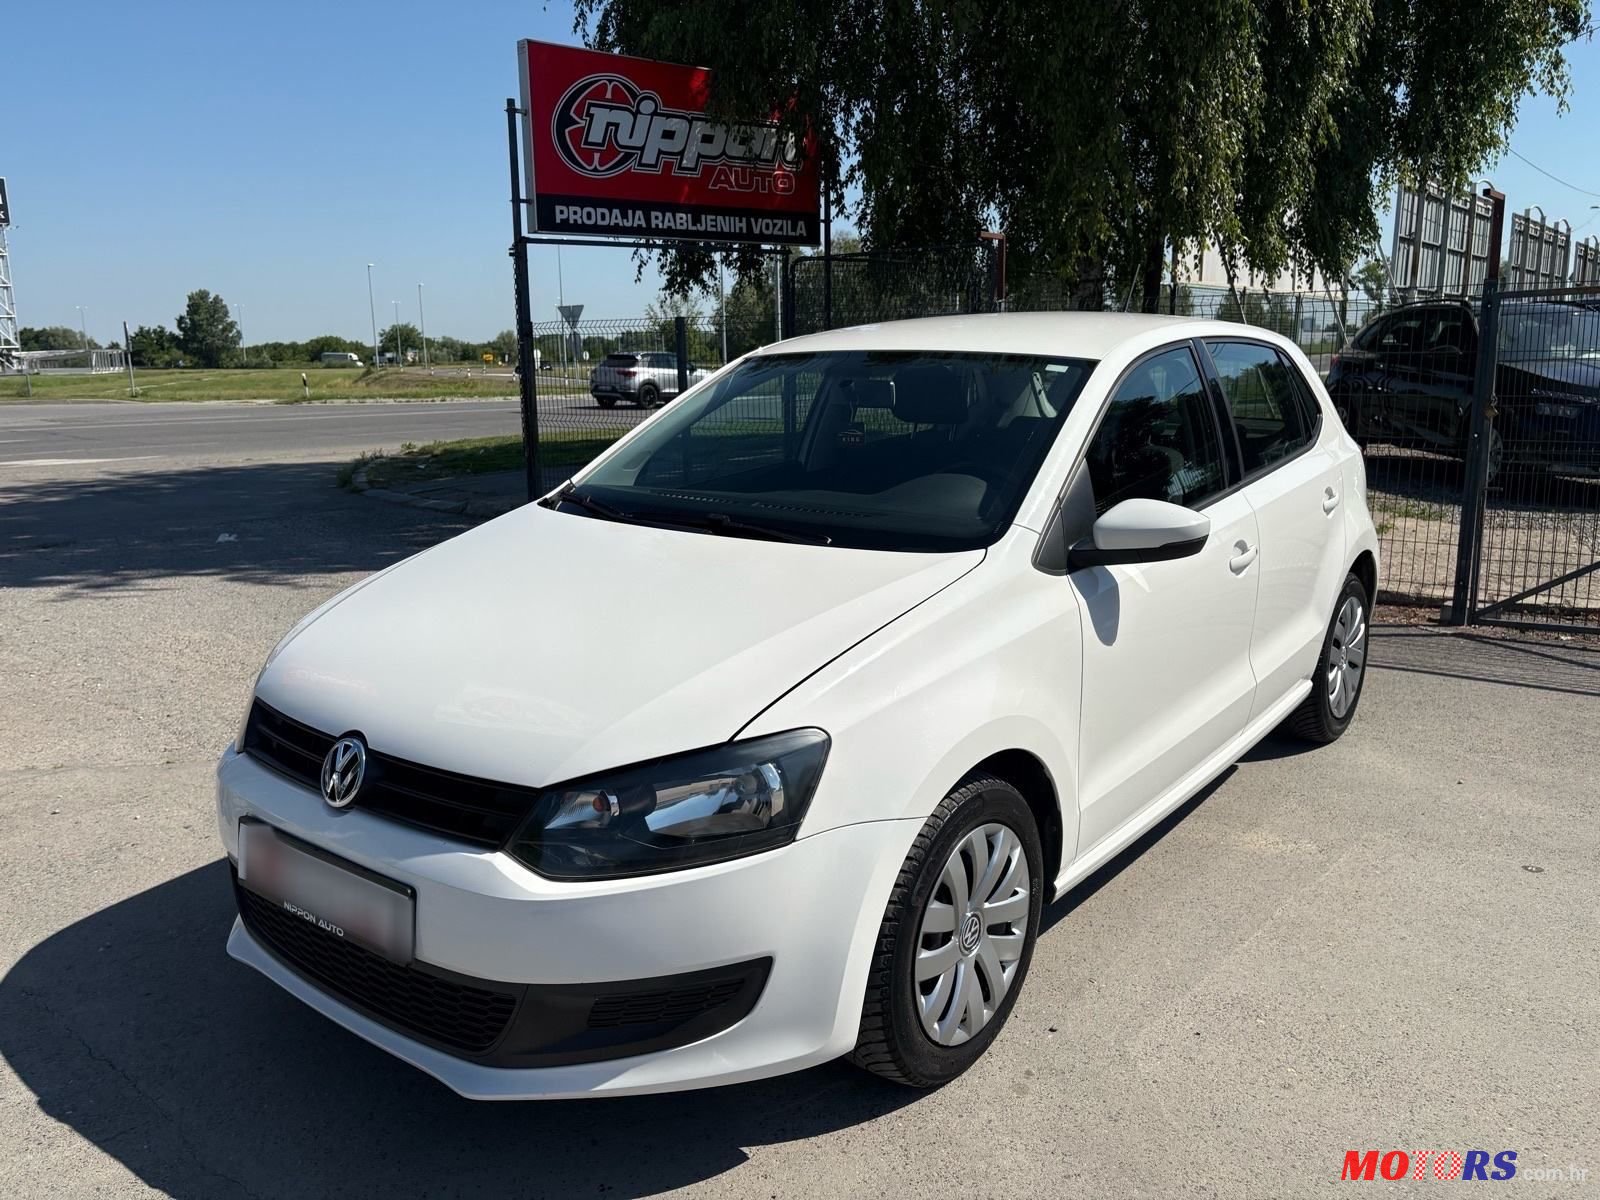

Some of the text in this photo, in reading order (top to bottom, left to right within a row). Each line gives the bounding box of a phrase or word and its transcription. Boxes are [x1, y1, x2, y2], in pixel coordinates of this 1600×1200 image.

[709, 166, 796, 194] AUTO
[554, 205, 808, 237] PRODAJA RABLJENIH VOZILA
[283, 900, 344, 937] NIPPON AUTO
